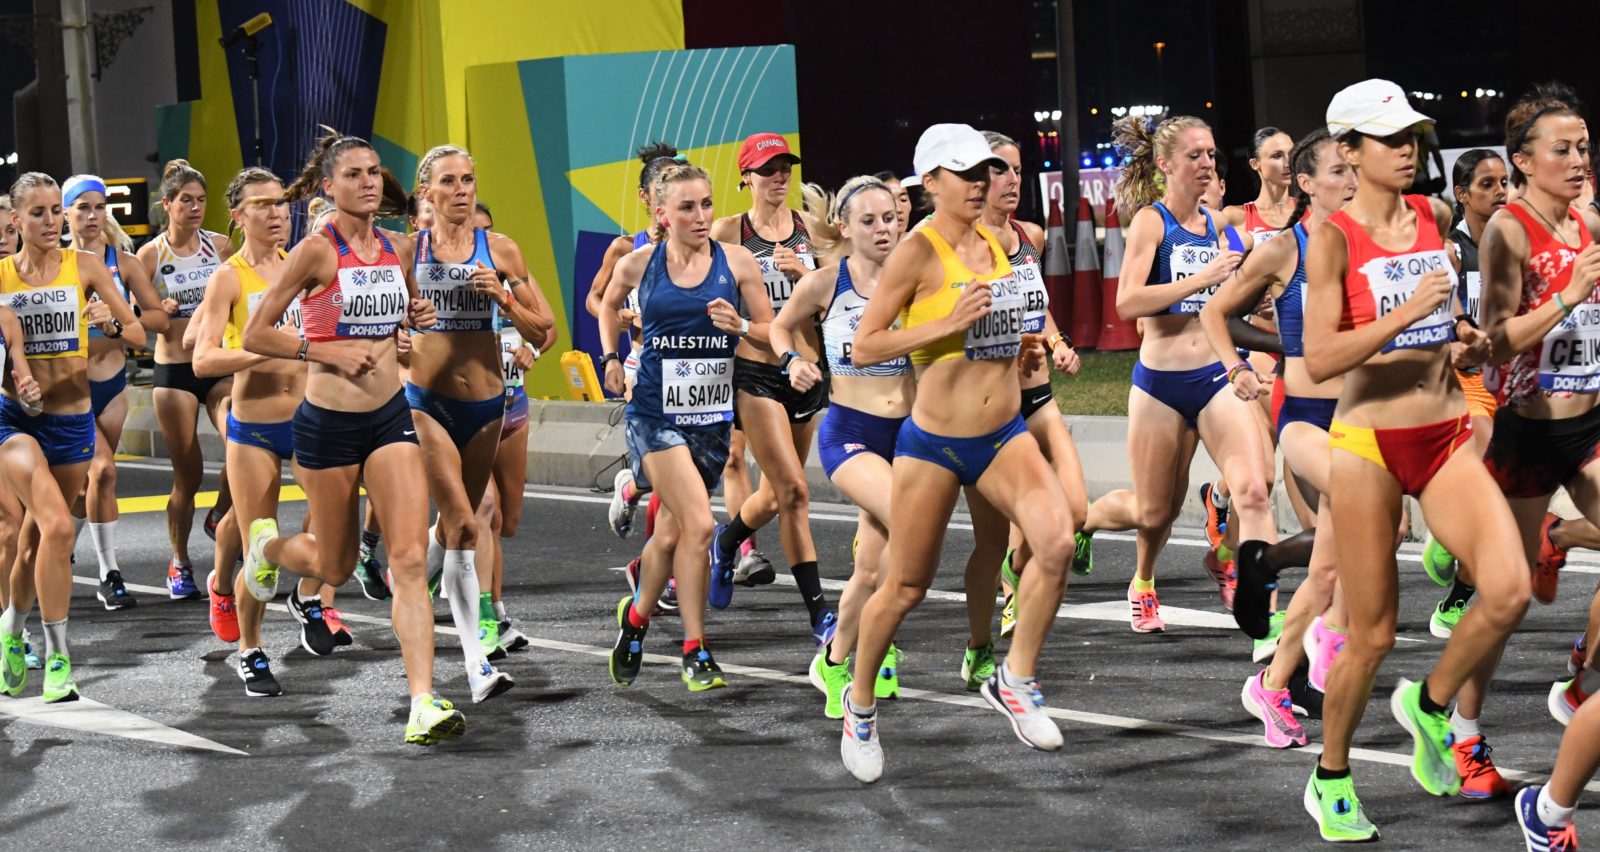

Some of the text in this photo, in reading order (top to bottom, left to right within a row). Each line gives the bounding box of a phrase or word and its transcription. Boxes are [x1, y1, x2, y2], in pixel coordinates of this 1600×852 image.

[1199, 250, 1219, 264] QN
[370, 269, 395, 284] QNB
[449, 267, 474, 281] QN
[31, 290, 67, 305] QNB
[991, 282, 1019, 298] QNB
[343, 287, 405, 317] JOGLOVÁ
[1579, 308, 1600, 326] QNB
[24, 341, 69, 353] OHA2019
[652, 335, 728, 350] PALESTINE
[694, 362, 727, 376] QNB
[666, 383, 730, 407] AL SAYAD
[675, 413, 723, 426] DOHA2019
